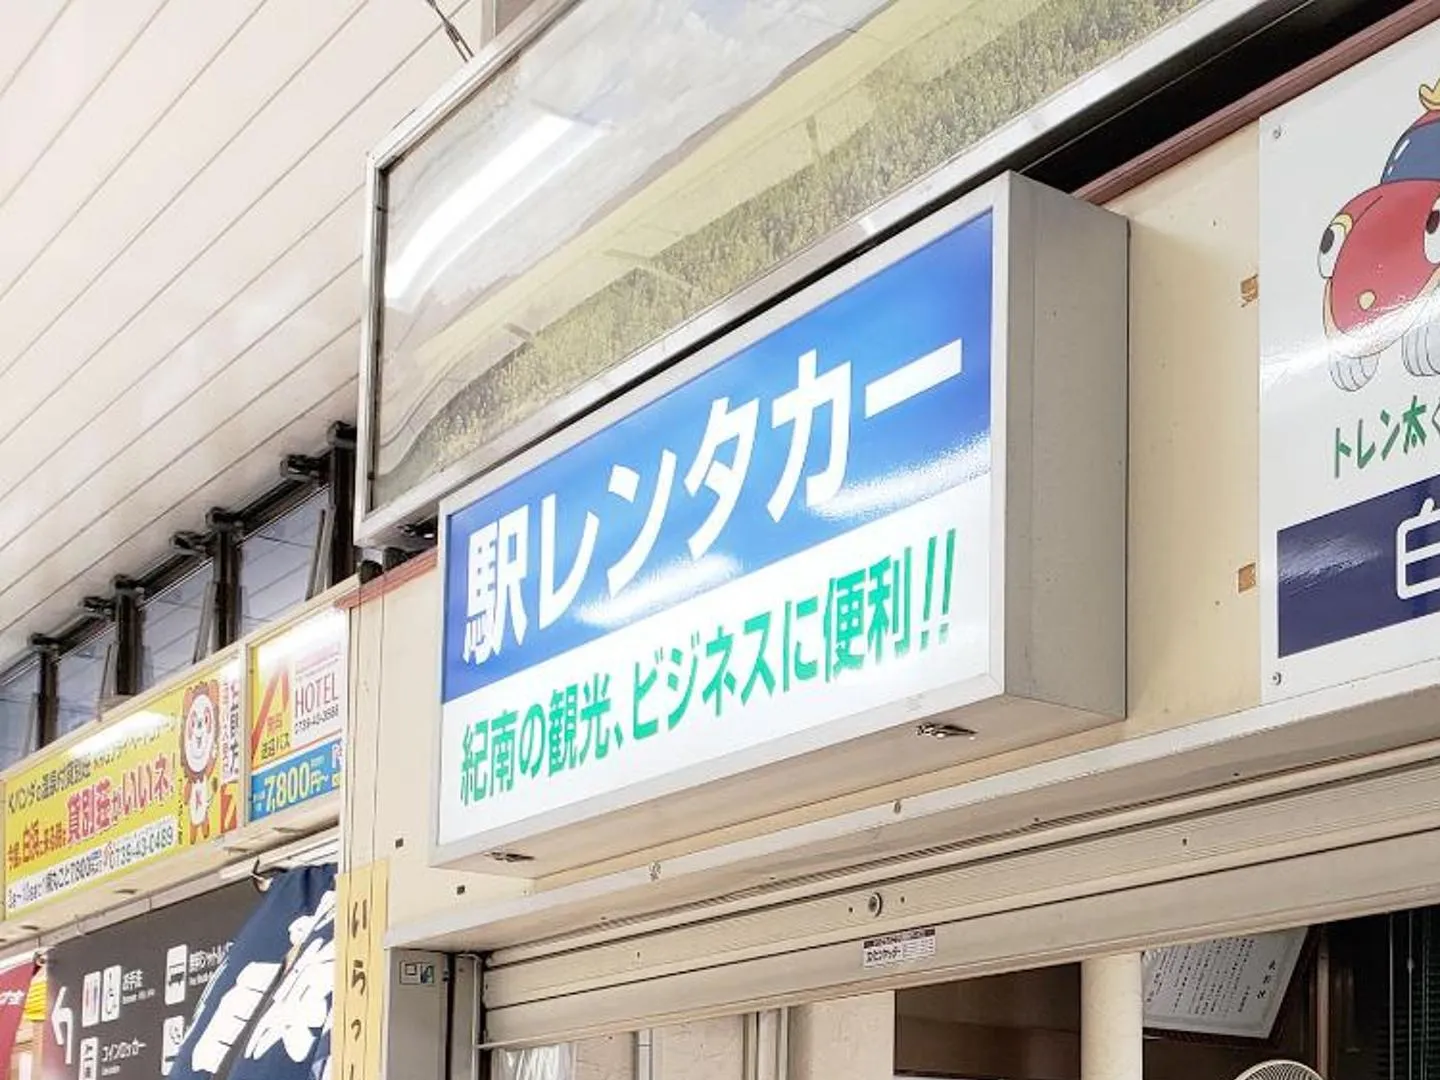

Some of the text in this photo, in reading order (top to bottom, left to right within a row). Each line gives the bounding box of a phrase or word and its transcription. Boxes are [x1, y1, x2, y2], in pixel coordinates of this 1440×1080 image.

[461, 338, 963, 665] 駅レンタカー
[295, 673, 338, 717] HOTEL
